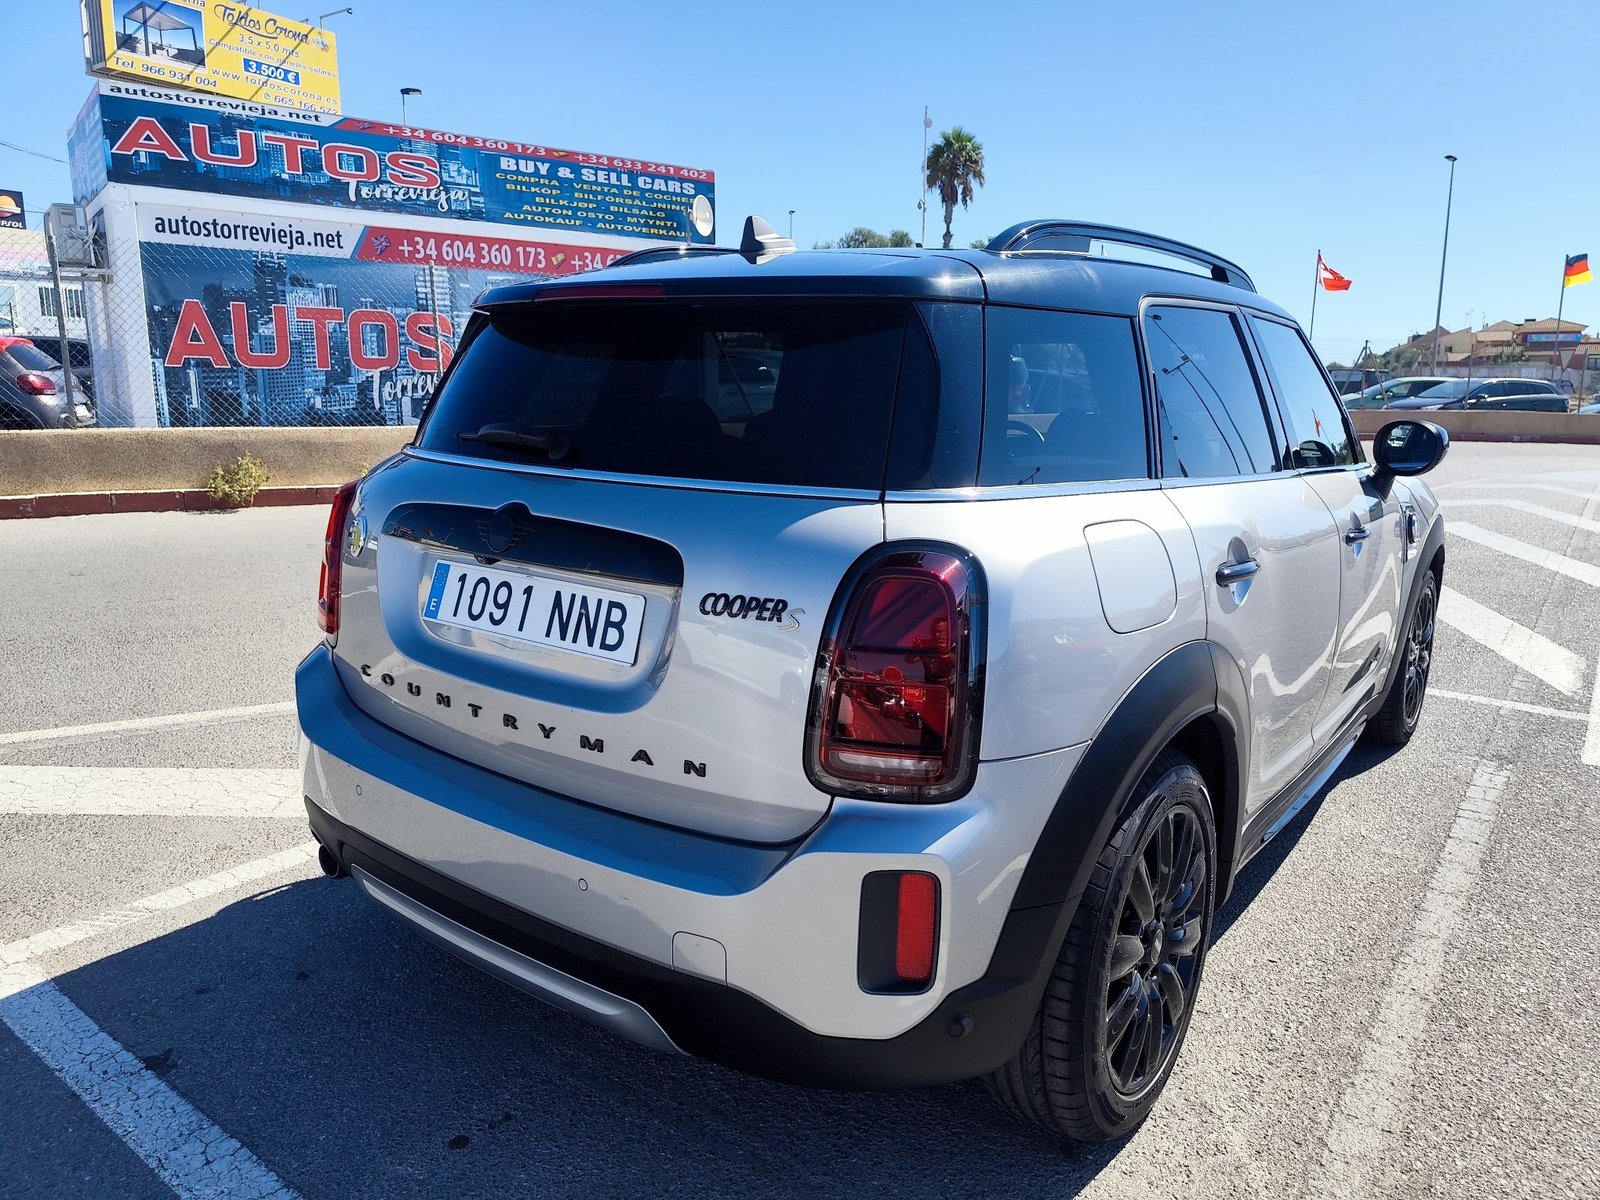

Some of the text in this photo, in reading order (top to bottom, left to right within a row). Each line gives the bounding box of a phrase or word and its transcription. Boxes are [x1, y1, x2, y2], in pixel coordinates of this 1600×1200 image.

[214, 4, 310, 45] Toldos Corona
[113, 56, 218, 88] Tel. 966 931 004
[209, 38, 337, 78] Compatible con paneles solares
[248, 61, 297, 83] 3.500 €
[109, 84, 323, 124] autostorrevieja.net
[274, 95, 295, 106] 665
[299, 100, 317, 111] 166
[110, 115, 441, 190] AUTOS
[383, 126, 708, 180] +34 604 360 173 +34 633 241 402
[495, 172, 560, 187] COMPRA
[572, 182, 619, 195] VENTA
[622, 188, 641, 198] DE
[500, 156, 696, 196] BUY & SELL CARS
[505, 183, 561, 196] BILKÖP
[341, 178, 470, 213] Torrevieja
[535, 196, 597, 209] BILKJØP
[609, 205, 666, 218] BILSALG
[0, 219, 24, 229] PSOL
[154, 215, 344, 250] autostorrevieja.net
[503, 212, 584, 227] AUTOKAUF
[521, 204, 573, 216] AUTON
[577, 211, 615, 221] OSTO
[626, 216, 678, 228] MYYNTI
[398, 236, 438, 260] +34
[442, 239, 476, 263] 604
[480, 242, 512, 266] 360
[516, 246, 547, 269] 173
[570, 251, 603, 271] +34
[165, 298, 454, 373] AUTOS
[364, 366, 442, 411] Torrev
[429, 572, 628, 652] E 1091 NNB
[699, 592, 789, 623] COOPER
[360, 663, 706, 778] COUNTRYMAN
